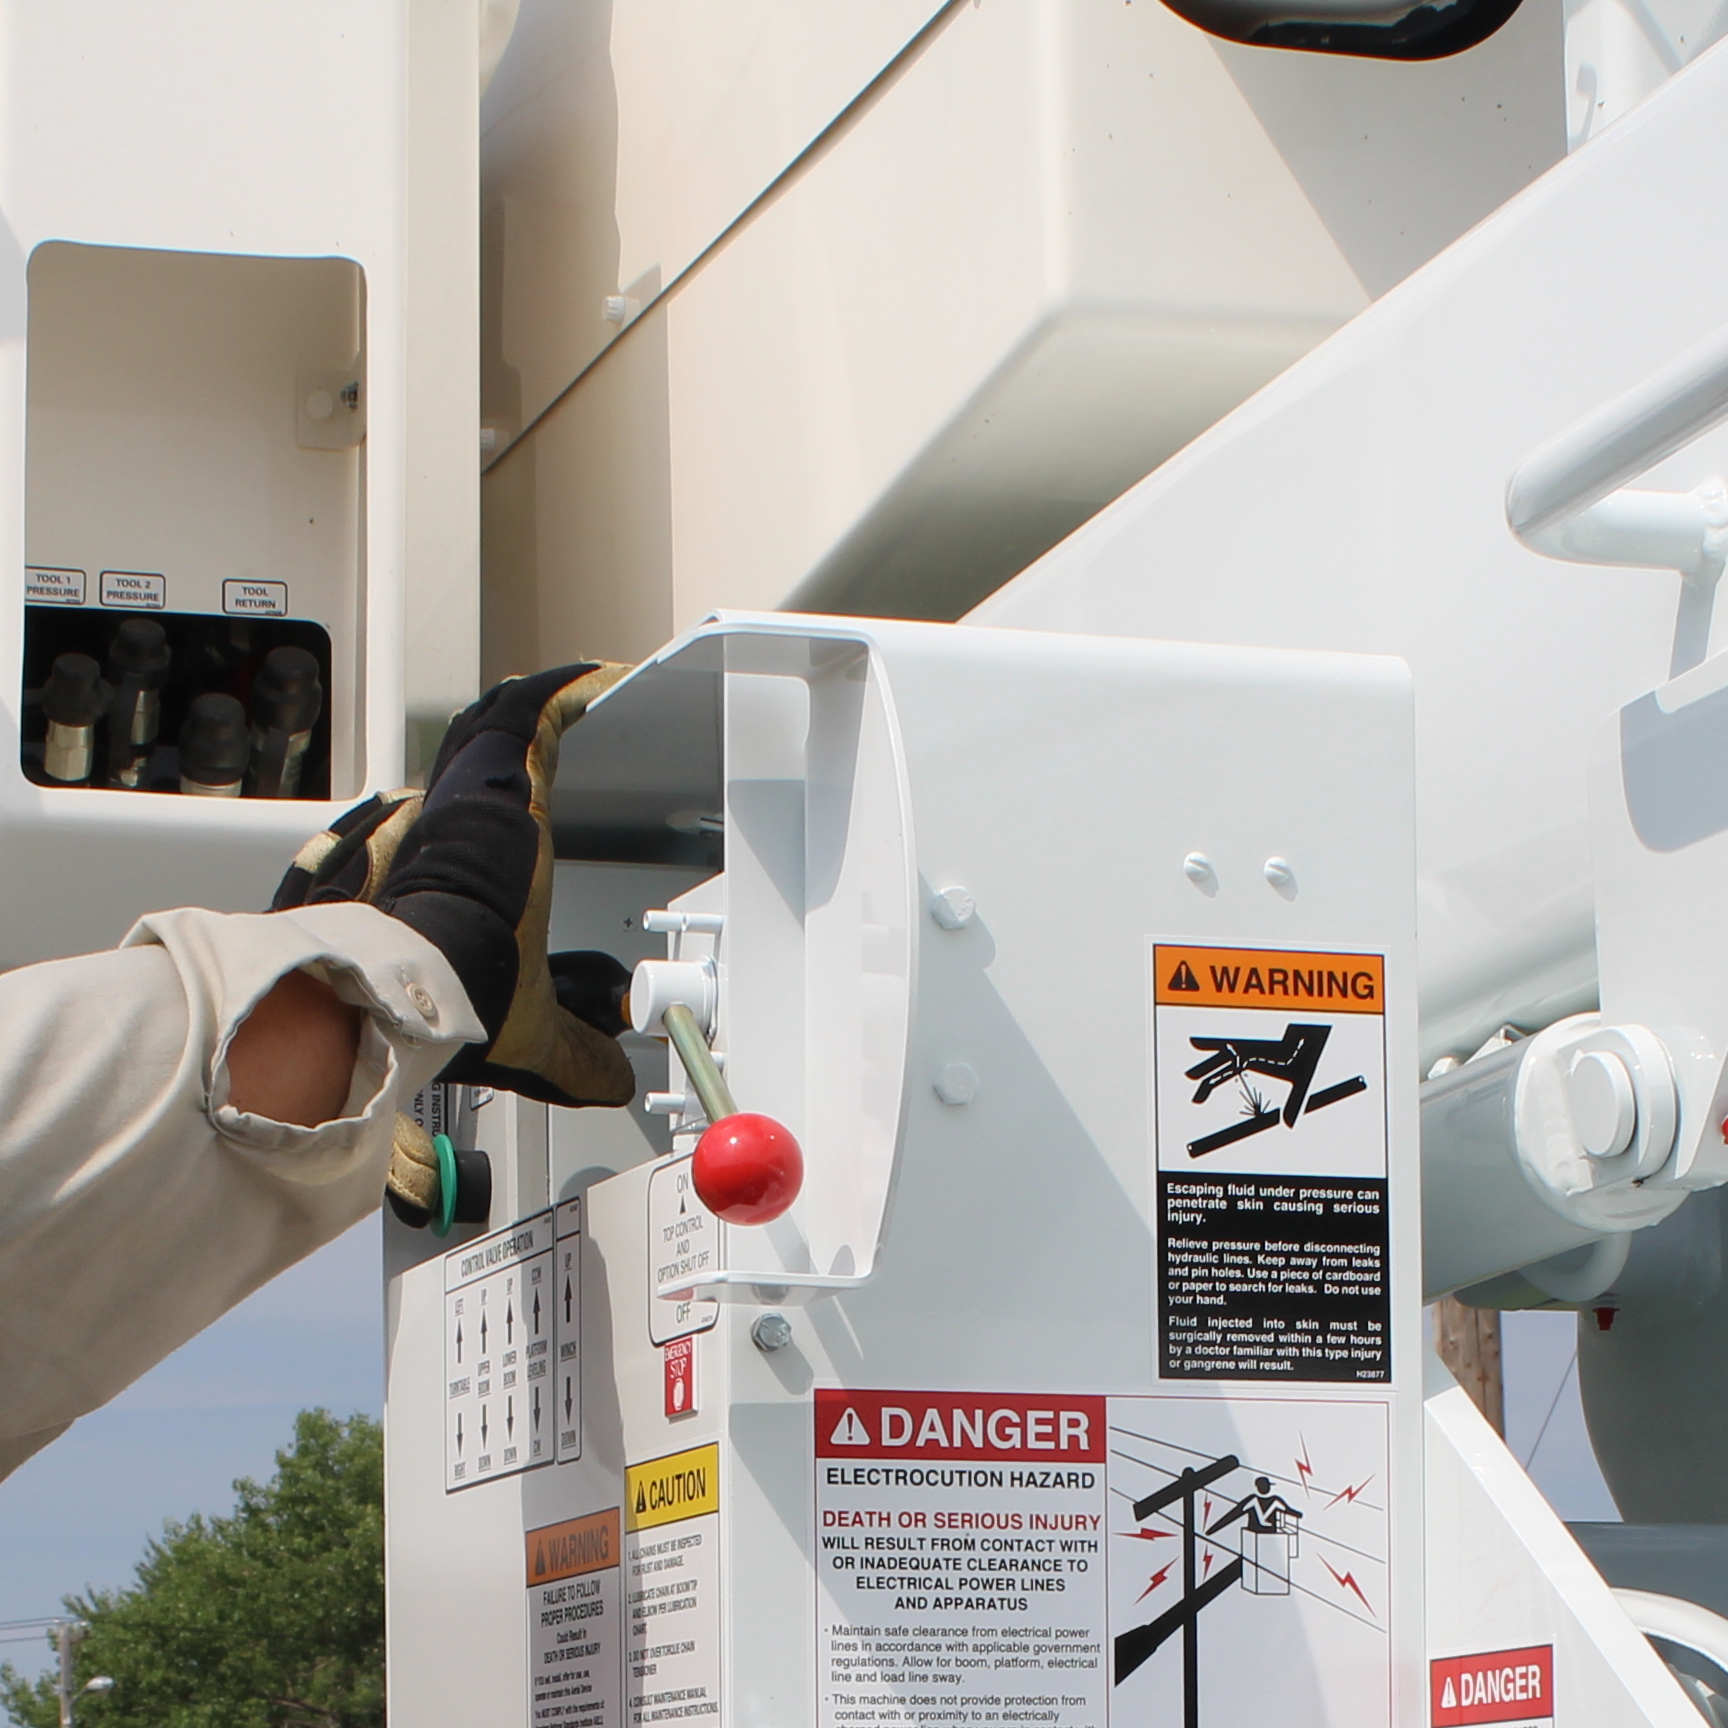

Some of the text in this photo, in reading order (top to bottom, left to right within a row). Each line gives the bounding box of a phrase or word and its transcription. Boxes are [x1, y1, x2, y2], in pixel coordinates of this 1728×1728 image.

[35, 573, 70, 584] TOOL 1
[115, 578, 150, 589] TOOL 2
[26, 585, 80, 597] PRESSURE
[106, 590, 159, 602] PRESSURE
[242, 586, 268, 596] TOOL
[235, 598, 276, 609] RETURN
[1210, 964, 1375, 1000] WARNING
[677, 1173, 688, 1194] ON
[1166, 1182, 1379, 1200] Escaping fluid under pressure can
[1166, 1198, 1380, 1215] penetrate skin causing serious
[1167, 1210, 1206, 1225] injury.
[662, 1215, 704, 1244] TOP CONTROL
[676, 1239, 690, 1256] AND
[658, 1250, 710, 1283] OPTION SHUT OFF
[676, 1302, 691, 1324] OFF
[1168, 1315, 1382, 1331] Fluid injected into skin must be
[1168, 1330, 1382, 1345] surgically removed within a few hours
[1168, 1344, 1382, 1361] by a doctor familiar with this type injury
[670, 1356, 687, 1378] STOP
[1168, 1359, 1294, 1371] or gangrene will result.
[880, 1406, 1090, 1450] DANGER
[826, 1467, 1095, 1489] ELECTROCUTION HAZARD
[649, 1467, 706, 1510] CAUTION
[822, 1510, 1100, 1530] DEATH OR SERIOUS INJURY
[548, 1524, 610, 1573] WARNING
[821, 1536, 1097, 1553] WILL RESULT FROM CONTACT WITH
[832, 1556, 1088, 1572] OR INADEQUATE CLEARANCE TO
[856, 1576, 1065, 1591] ELECTRICAL POWER LINES
[544, 1579, 600, 1606] FAILURE TO FOLLOW
[894, 1596, 1028, 1611] AND APPARATUS
[541, 1600, 604, 1627] PROPER PROCEDURES
[831, 1624, 1089, 1640] Maintain safe clearance from electrical power
[830, 1640, 1100, 1655] lines in accordance with applicable government
[831, 1655, 1097, 1670] regulations. Allow for boom, platform, electrical
[1460, 1664, 1541, 1707] DANGER
